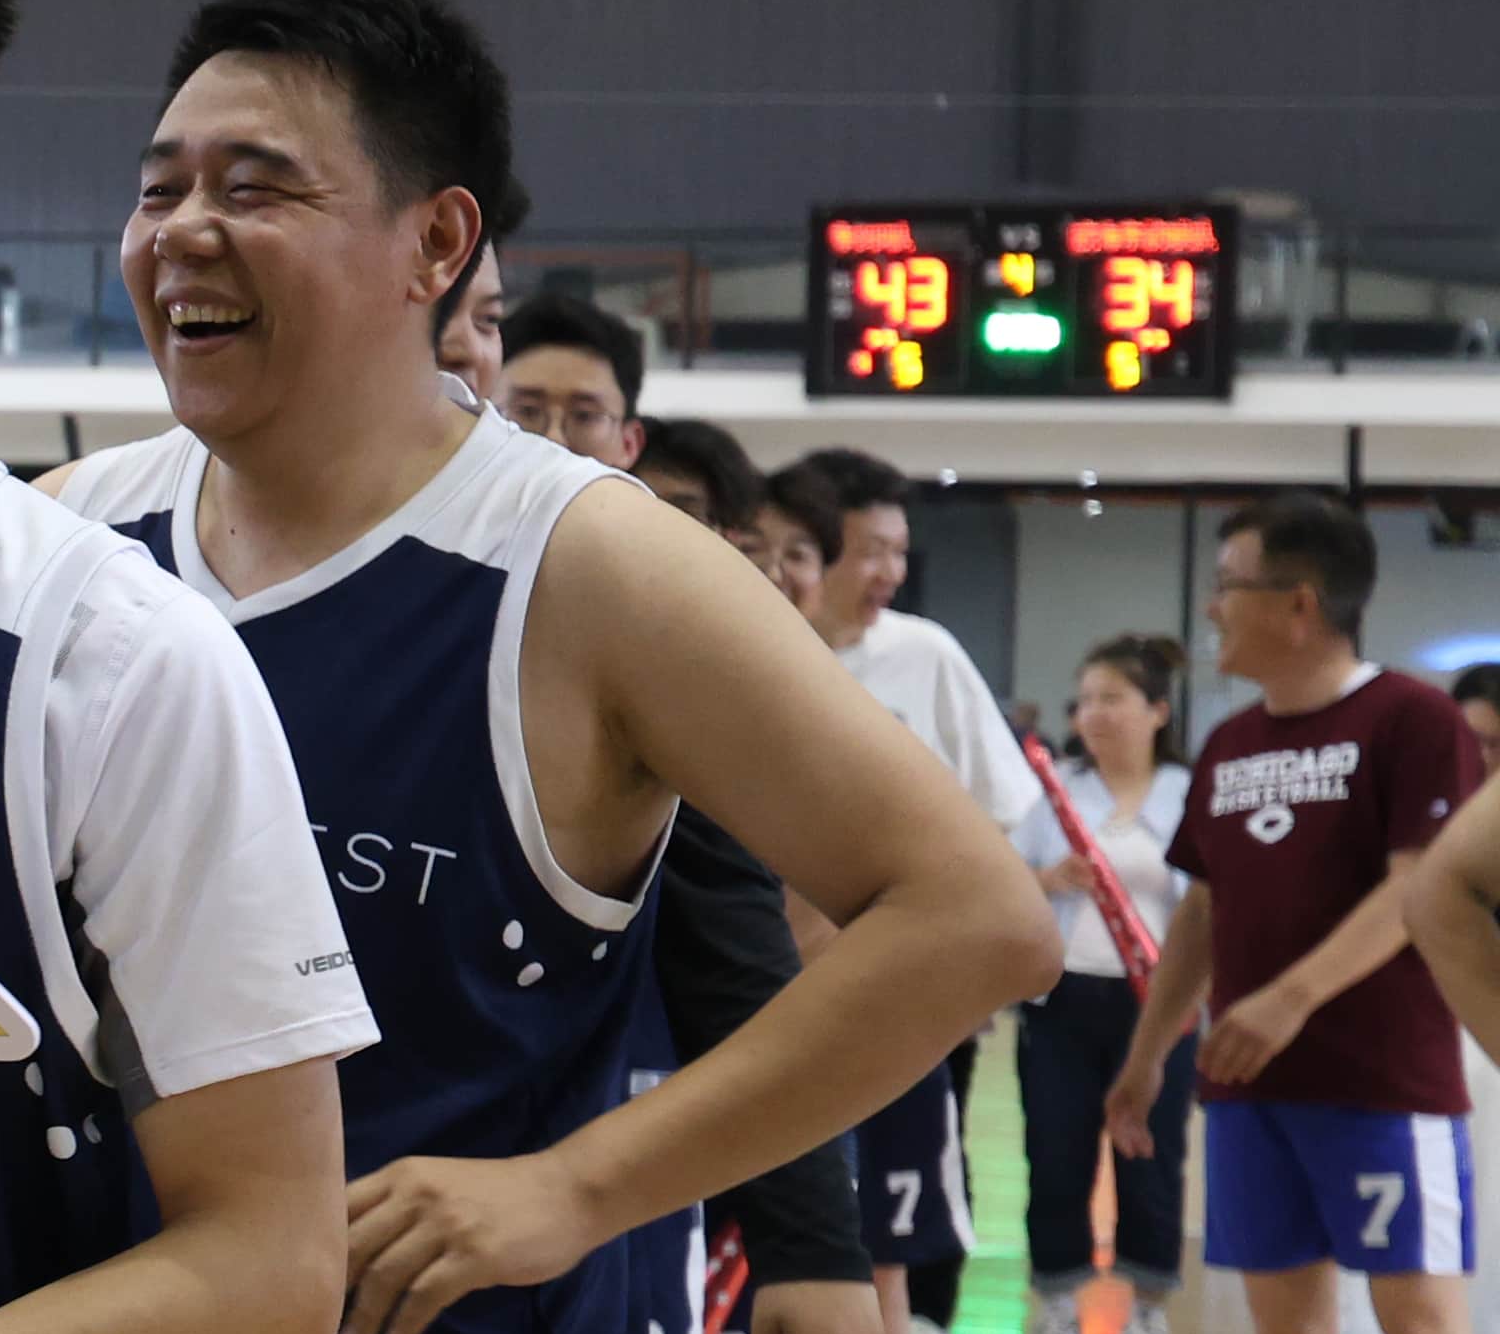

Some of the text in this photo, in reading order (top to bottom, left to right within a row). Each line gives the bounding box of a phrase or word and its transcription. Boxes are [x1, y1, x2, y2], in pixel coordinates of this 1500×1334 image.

[857, 256, 948, 331] 43
[1103, 256, 1194, 331] 34
[310, 823, 457, 905] ST
[887, 1169, 922, 1237] 7
[1355, 1172, 1405, 1248] 7
